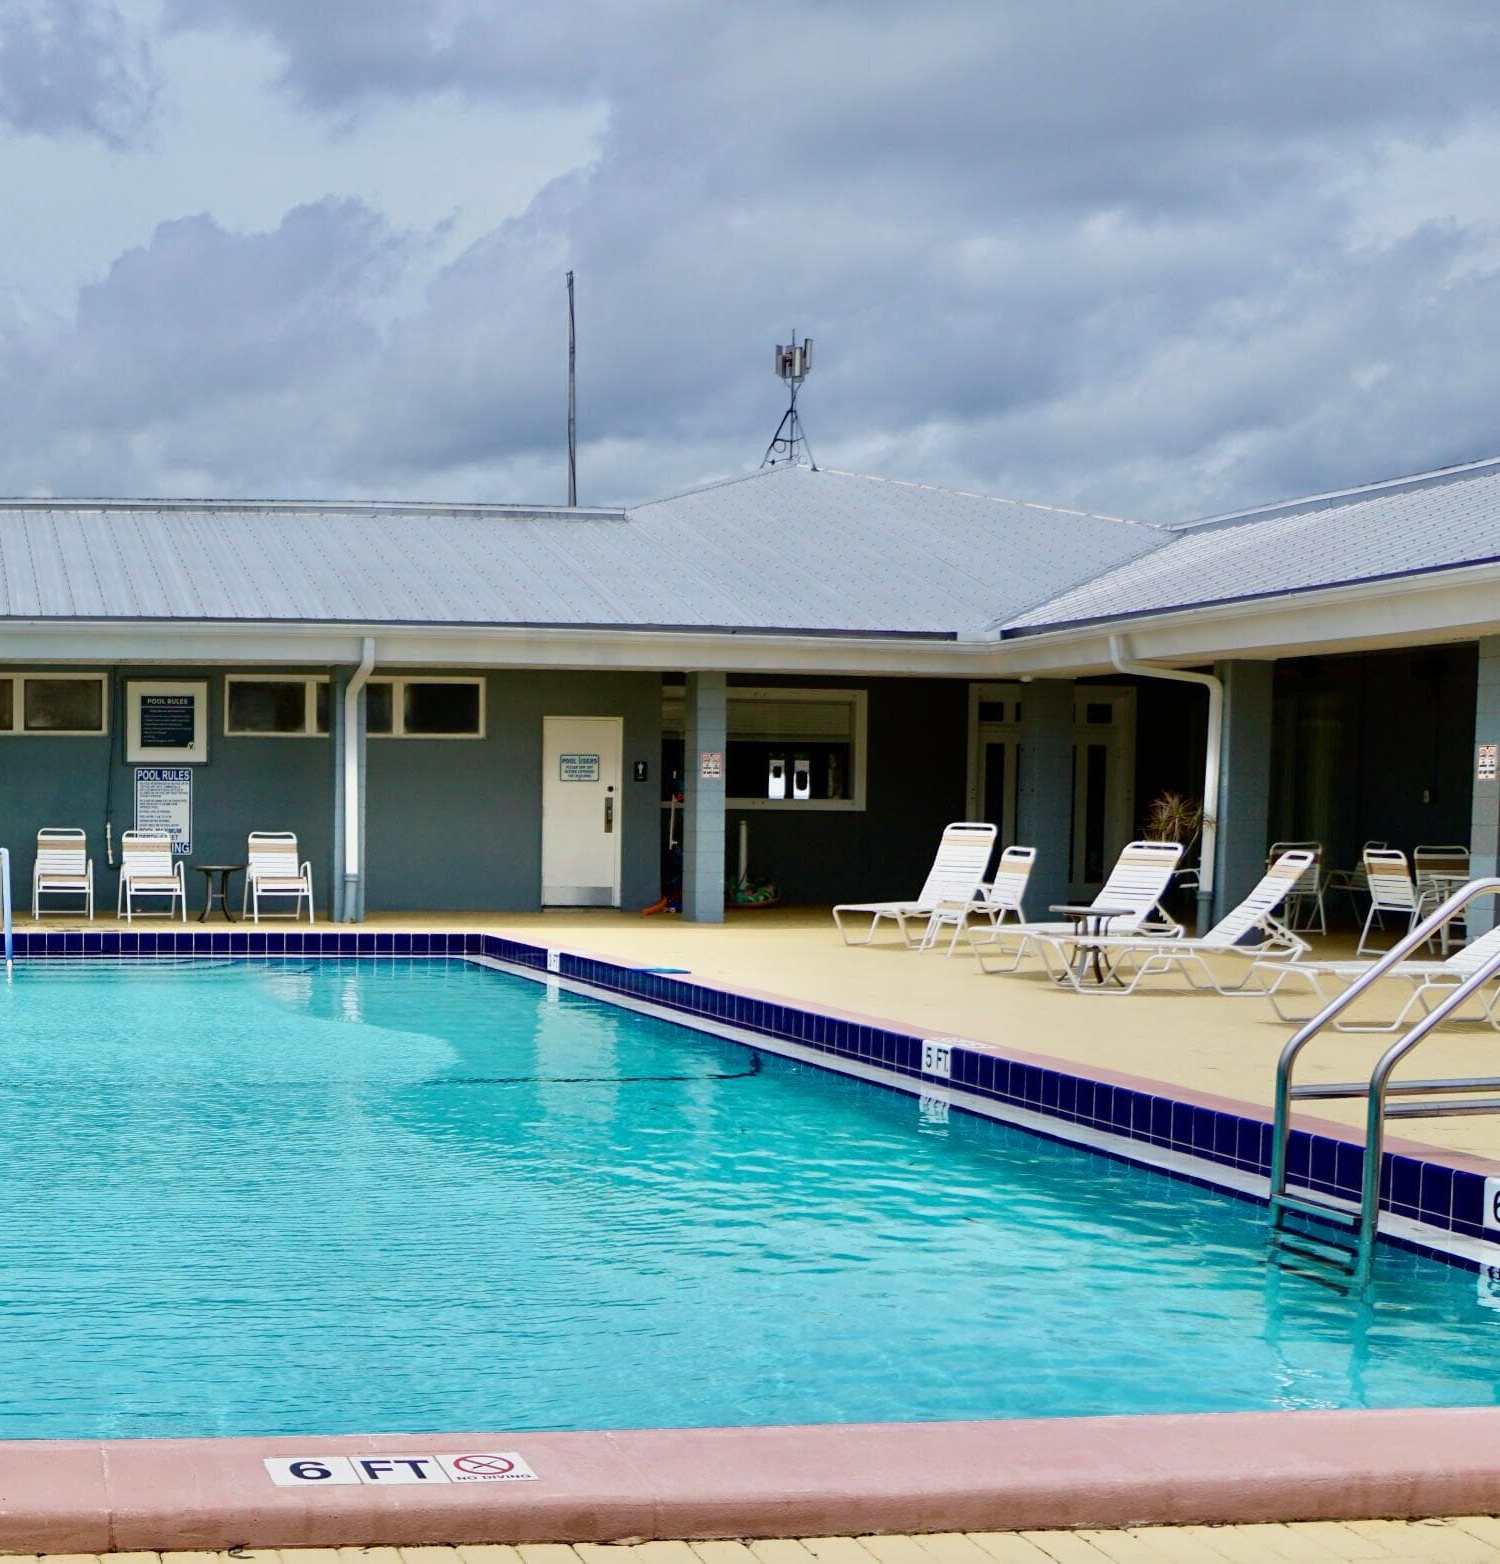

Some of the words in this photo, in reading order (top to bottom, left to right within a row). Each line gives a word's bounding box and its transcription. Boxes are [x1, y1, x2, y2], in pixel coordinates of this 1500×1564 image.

[137, 770, 160, 781] POOL
[162, 770, 190, 781] RULES
[926, 1047, 932, 1068] 5
[289, 1461, 332, 1480] 6
[360, 1459, 429, 1480] FT
